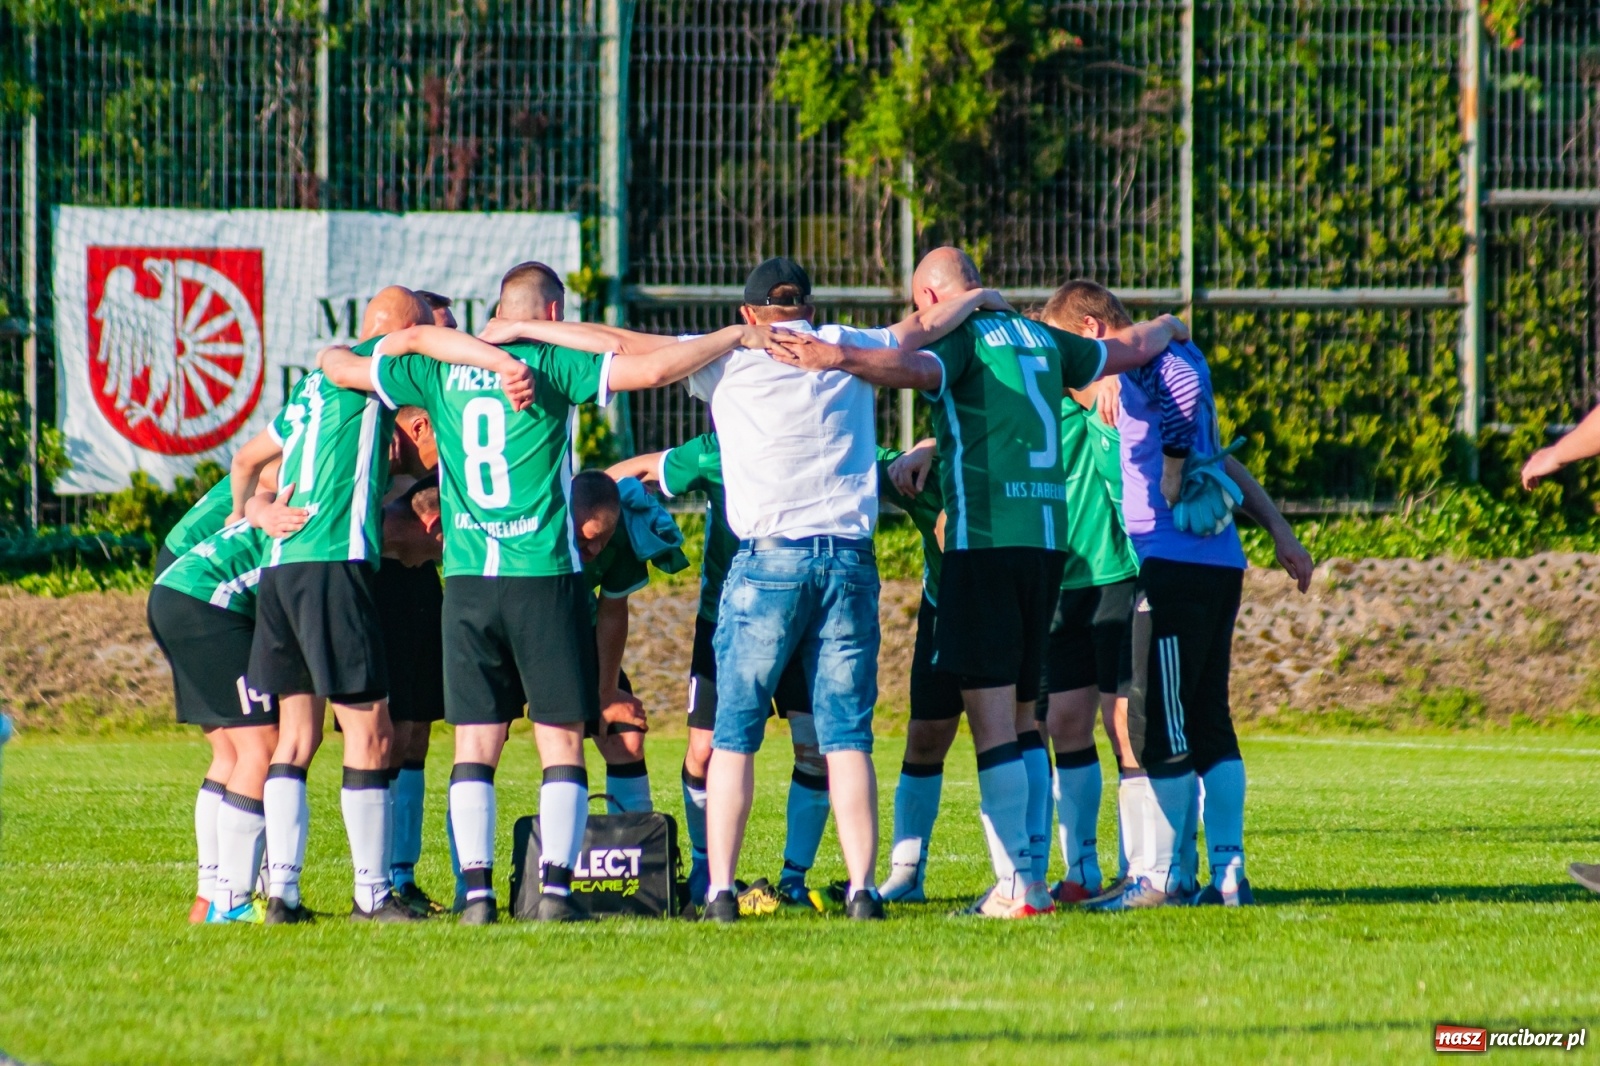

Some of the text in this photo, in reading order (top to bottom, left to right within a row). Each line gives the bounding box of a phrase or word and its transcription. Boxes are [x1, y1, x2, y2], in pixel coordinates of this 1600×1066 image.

[1019, 355, 1057, 469] 5
[462, 396, 511, 509] 8
[1005, 482, 1027, 498] LKS
[538, 848, 642, 878] LECT
